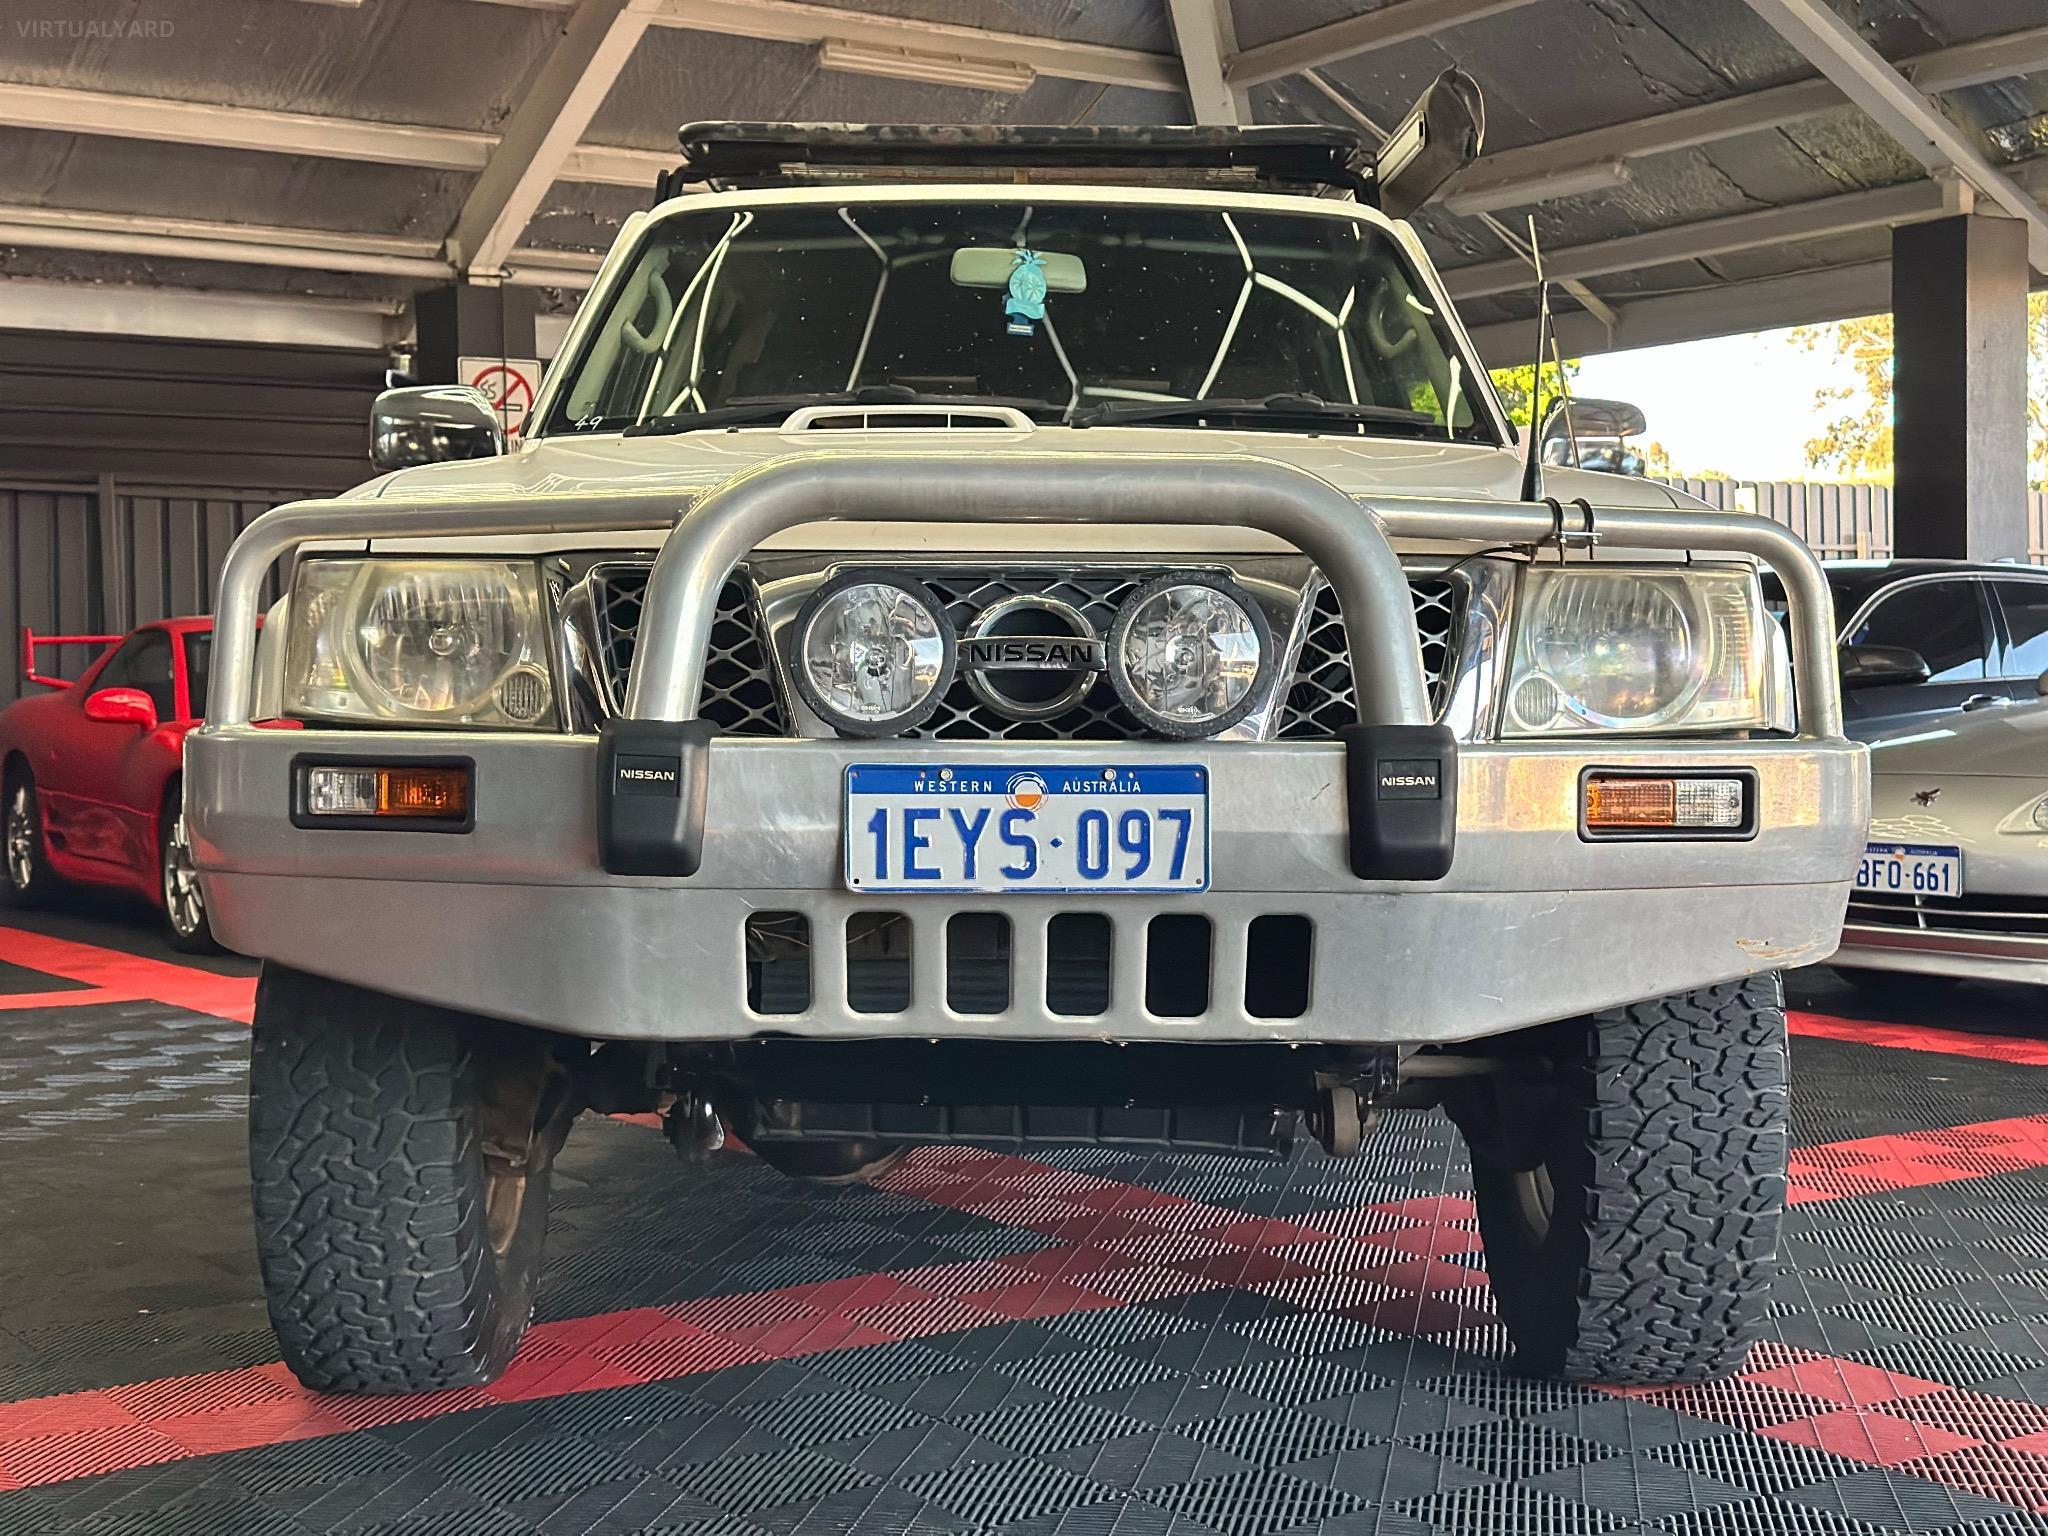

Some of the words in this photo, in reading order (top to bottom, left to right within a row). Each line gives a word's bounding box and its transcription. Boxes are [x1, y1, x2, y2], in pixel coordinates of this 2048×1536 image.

[574, 413, 604, 431] 49
[969, 643, 1093, 663] NISSAN
[620, 768, 675, 781] NISSAN
[1381, 775, 1436, 787] NISSAN
[913, 780, 993, 793] WESTERN
[1062, 780, 1142, 793] AUSTRALIA
